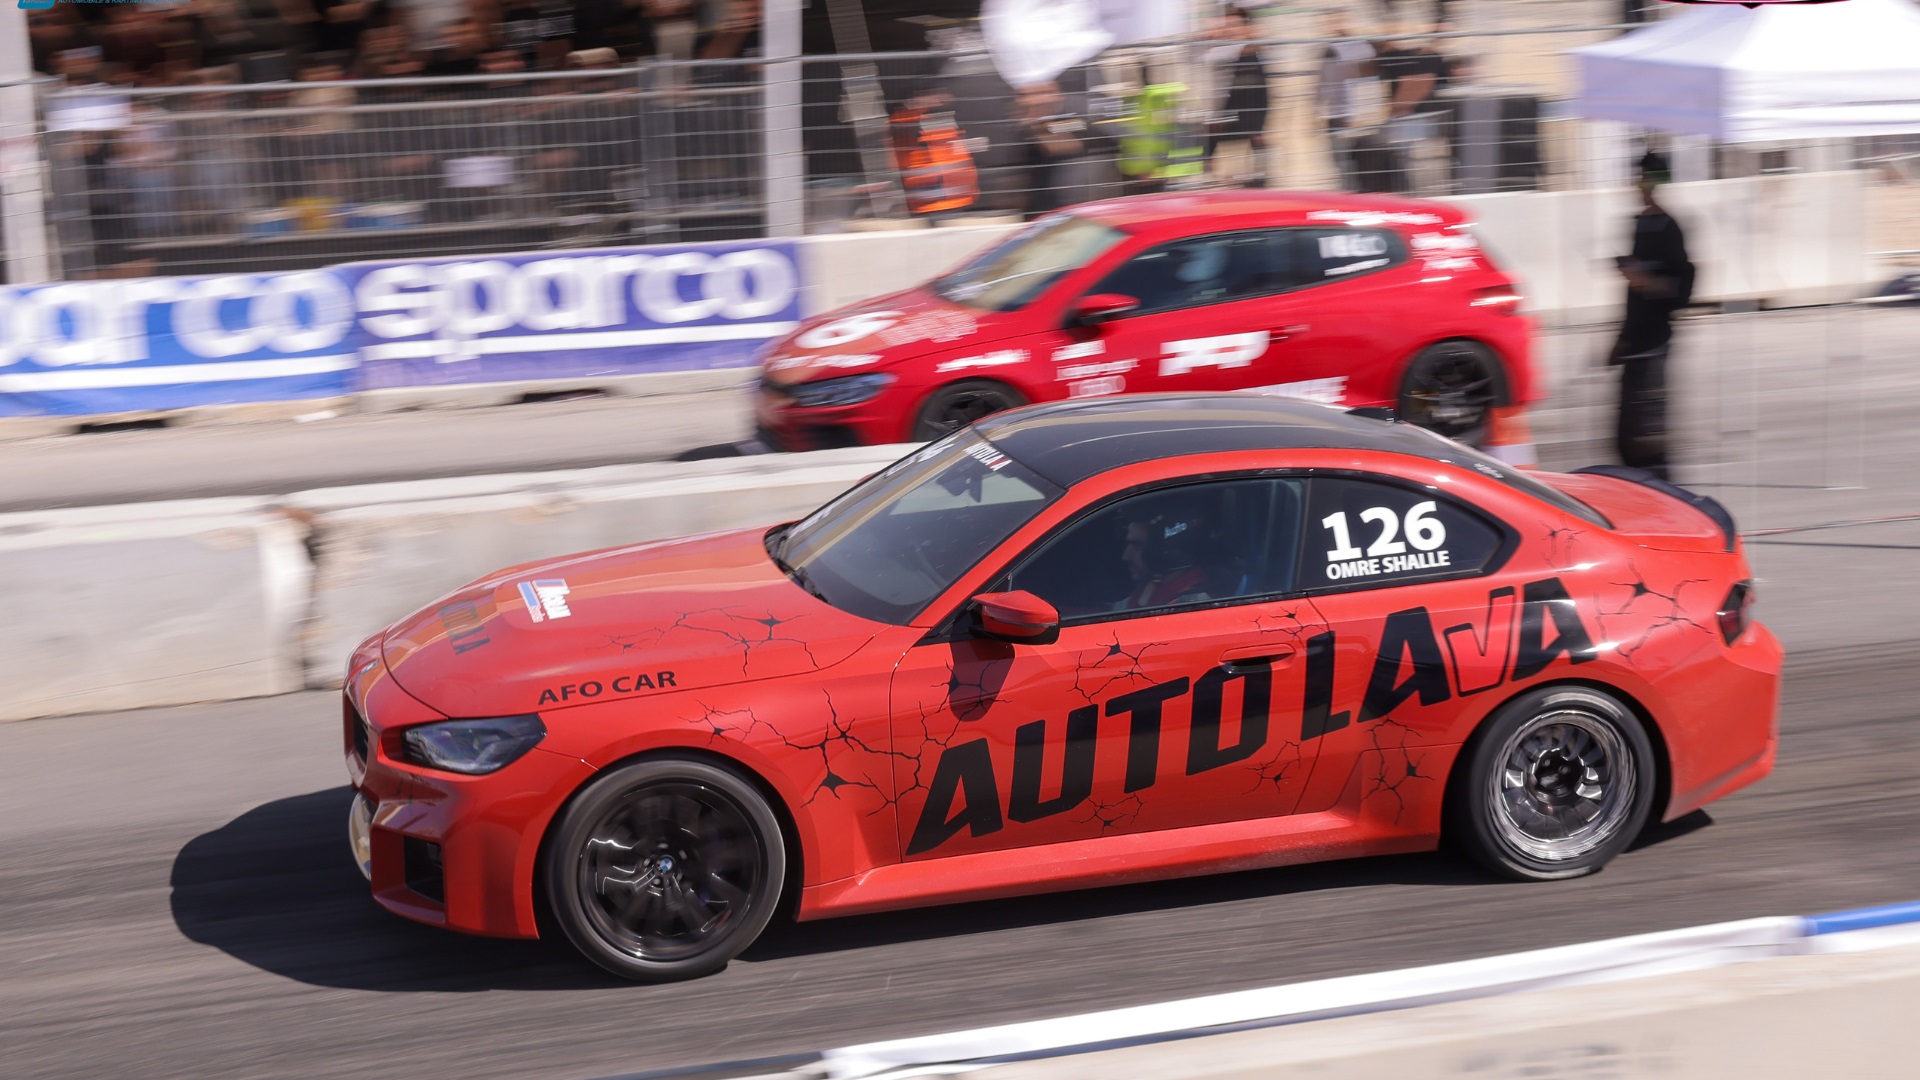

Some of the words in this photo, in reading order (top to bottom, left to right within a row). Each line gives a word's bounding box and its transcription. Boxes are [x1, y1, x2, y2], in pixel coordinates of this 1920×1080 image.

[356, 249, 796, 363] sparco
[1322, 500, 1446, 562] 126
[1326, 558, 1381, 580] OMRE
[1383, 550, 1451, 573] SHALLE
[538, 681, 603, 706] AFO
[612, 671, 677, 693] CAR
